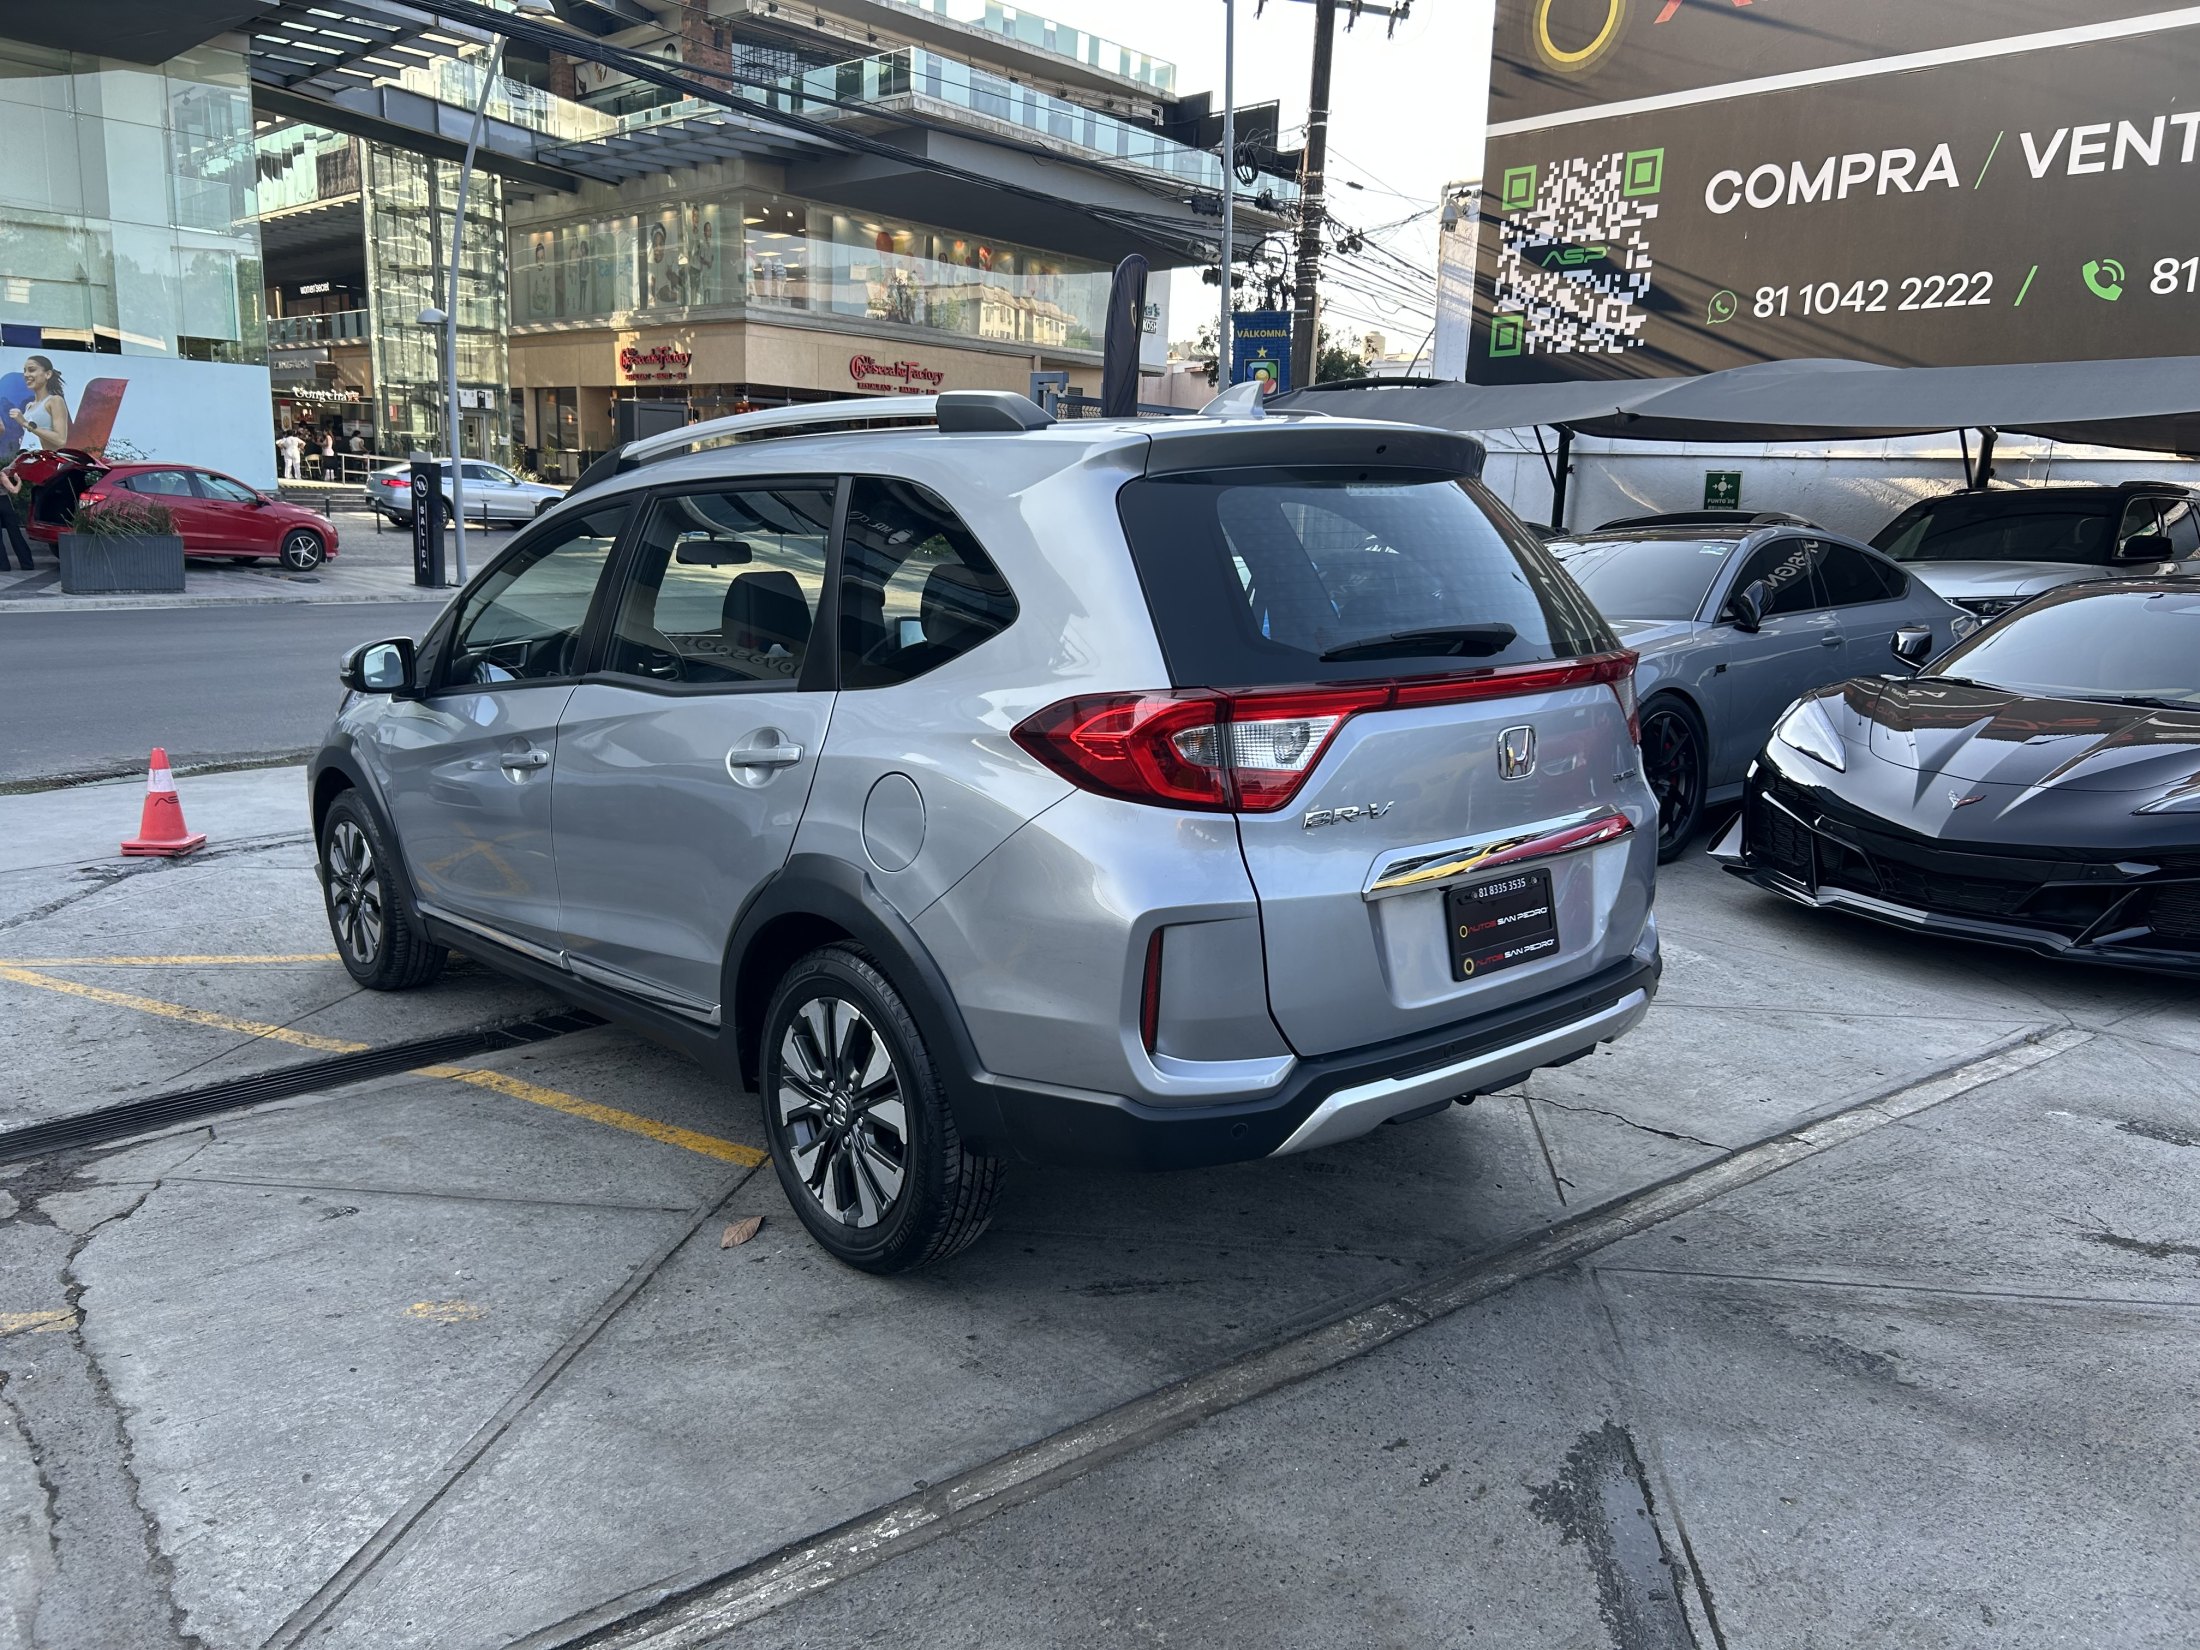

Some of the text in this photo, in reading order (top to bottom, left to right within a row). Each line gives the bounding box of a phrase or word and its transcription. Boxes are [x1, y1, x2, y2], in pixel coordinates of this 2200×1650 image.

[1704, 142, 1960, 214] COMPRA
[2020, 111, 2200, 179] VENT
[1753, 285, 1789, 318] 81
[1799, 279, 1889, 315] 1042
[1898, 271, 1993, 311] 2222
[2150, 256, 2199, 295] 81
[1237, 329, 1288, 338] VÄLKOMNA
[849, 354, 944, 386] Cheesecake Factory
[292, 386, 326, 402] Gong
[419, 506, 428, 569] SALIDA
[1302, 800, 1395, 830] BR-V
[1479, 878, 1526, 898] 81 8335 3535
[1469, 906, 1548, 932] AUTOS SAN PEDRO
[1476, 939, 1554, 966] AUTOS SAN PEDRO
